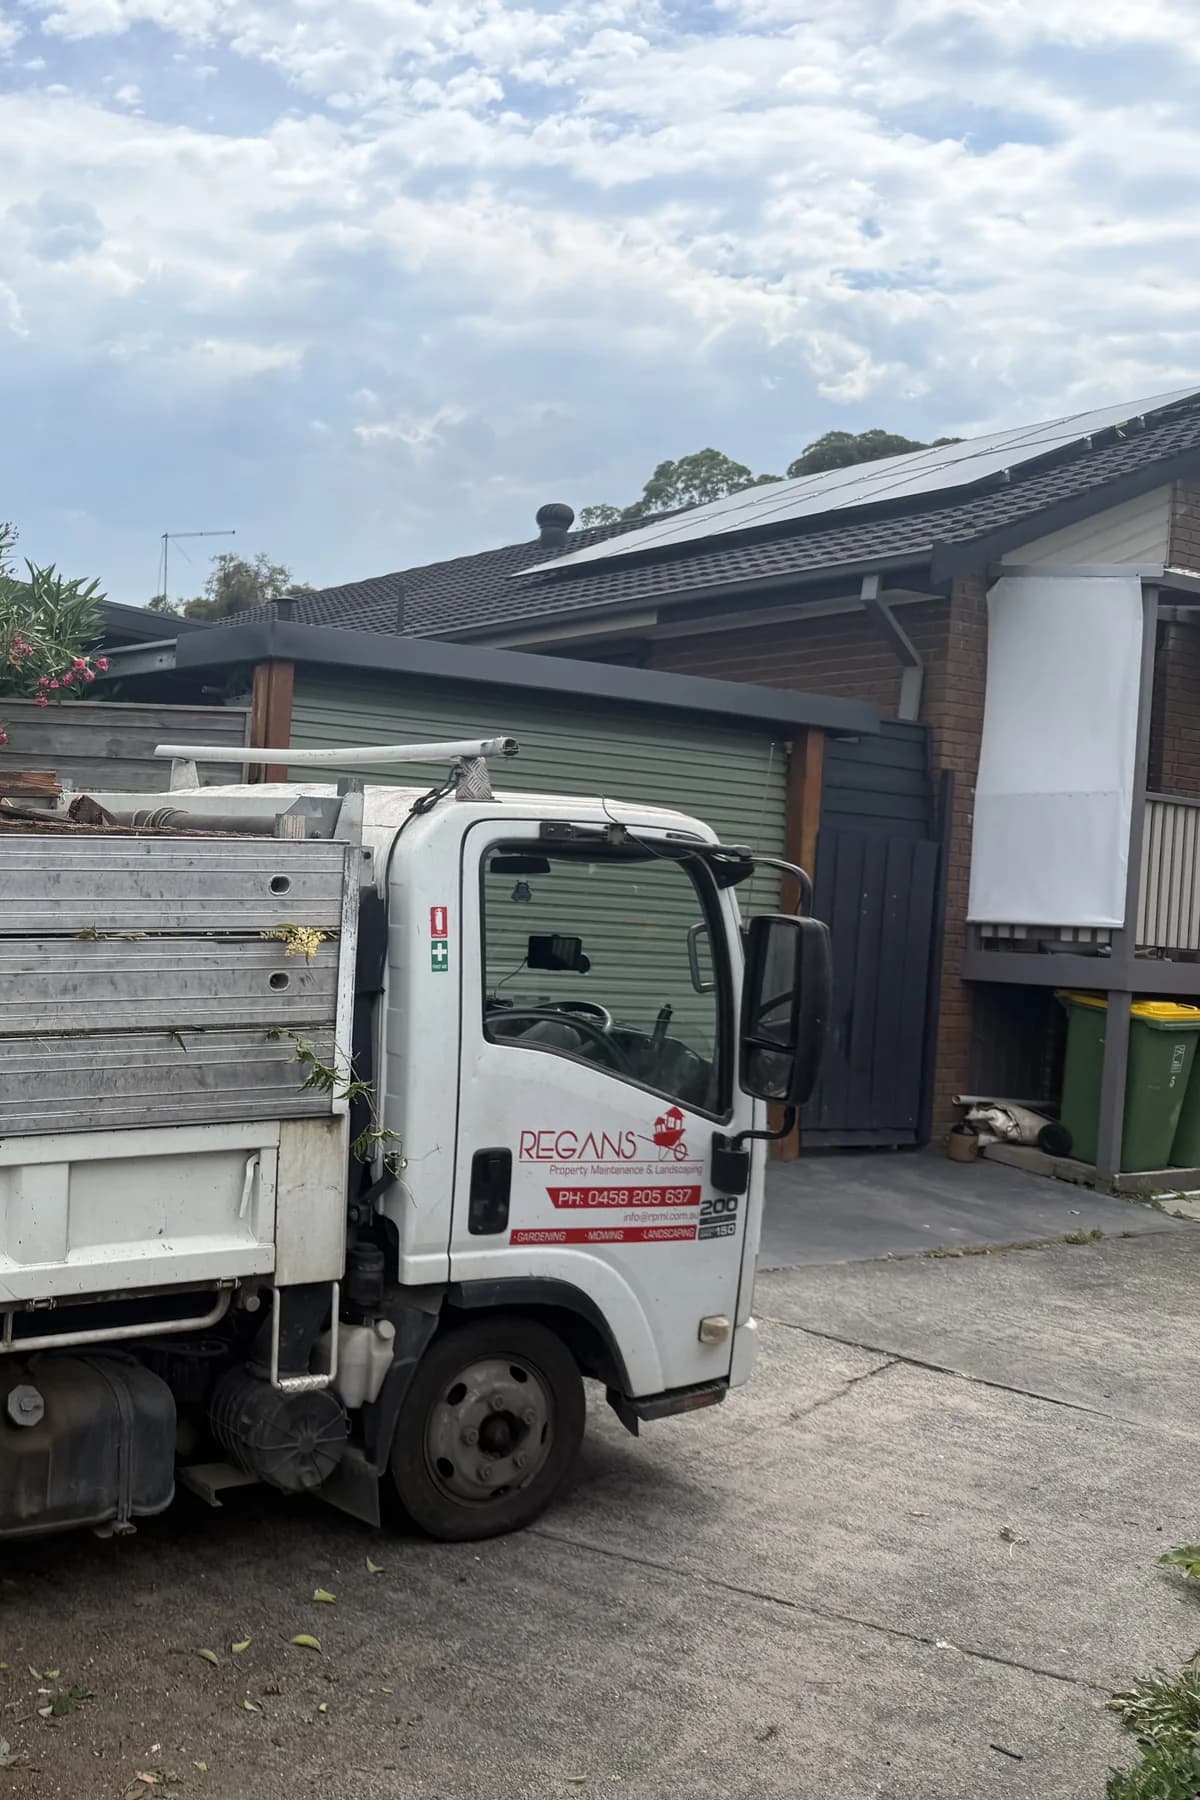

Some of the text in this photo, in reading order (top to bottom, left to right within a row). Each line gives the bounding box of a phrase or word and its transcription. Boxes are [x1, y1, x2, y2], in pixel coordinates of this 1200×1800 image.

[519, 1130, 637, 1160] REGANS
[550, 1164, 587, 1178] Property
[591, 1164, 644, 1176] Maintenance
[655, 1164, 703, 1177] Landscaping
[558, 1188, 692, 1206] PH: 0458 205 637
[700, 1197, 738, 1216] 200
